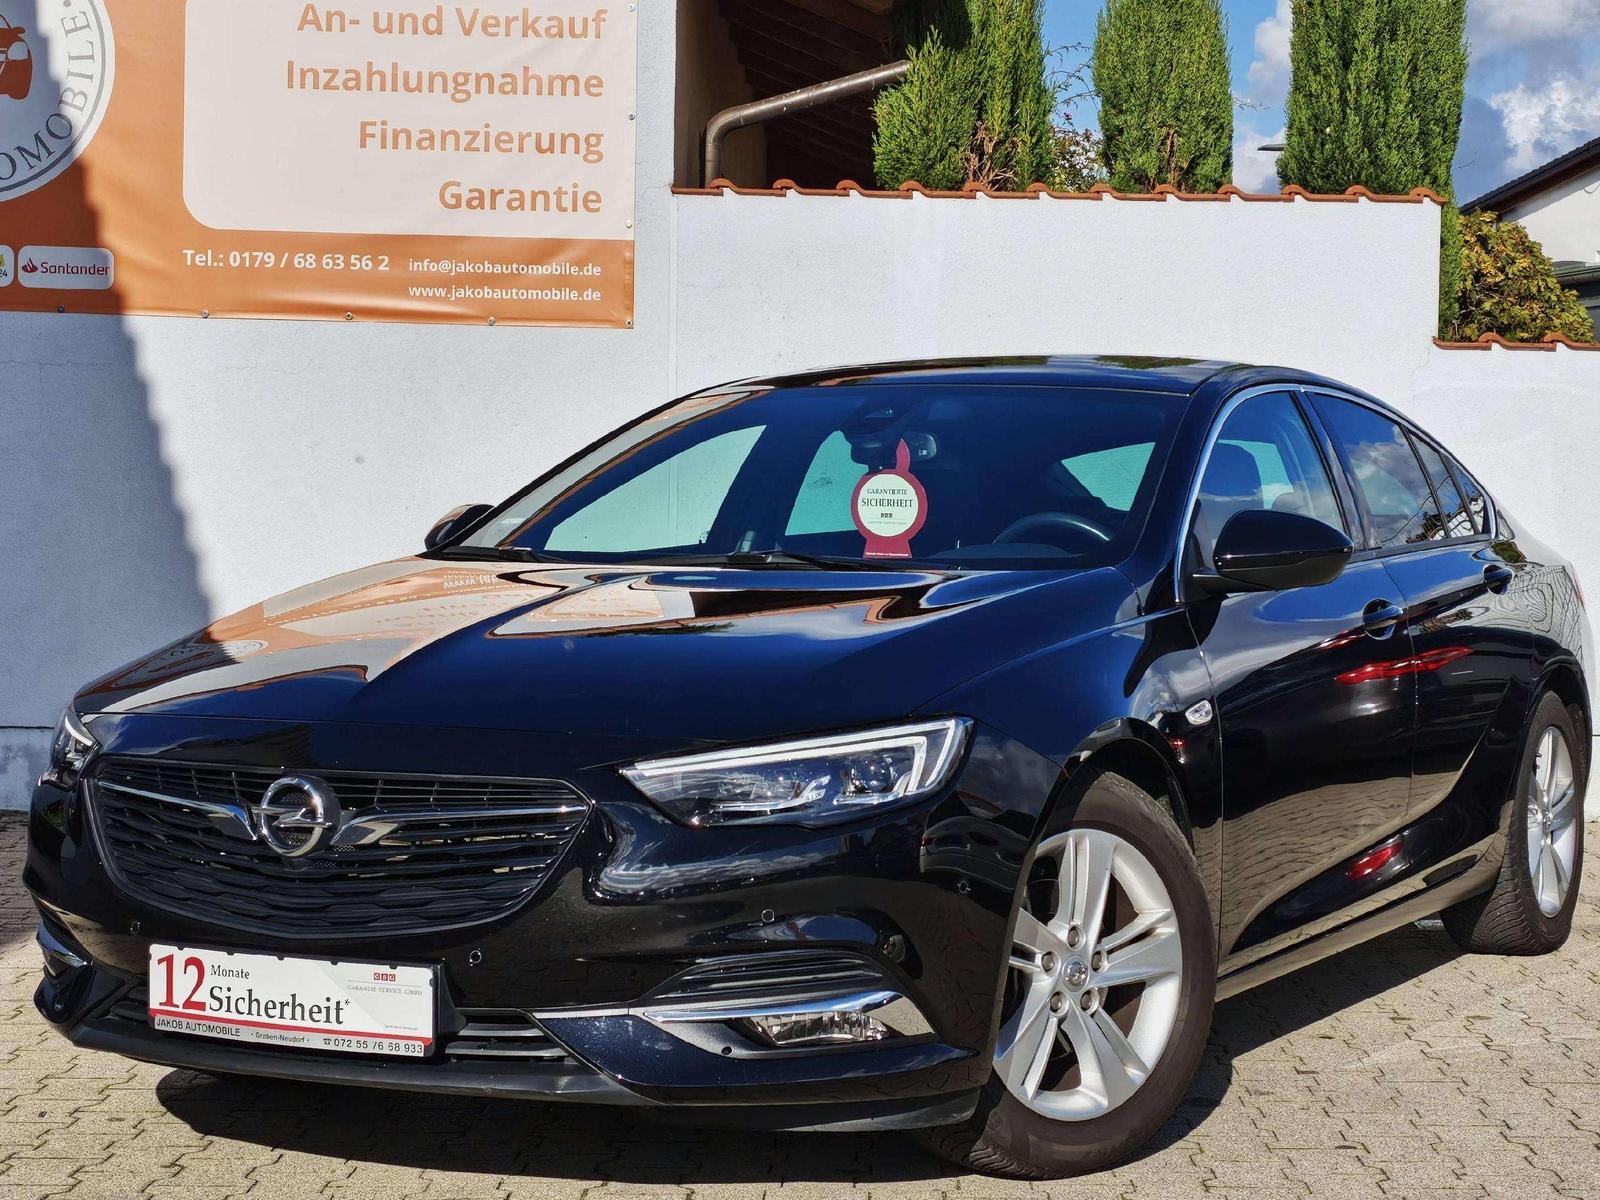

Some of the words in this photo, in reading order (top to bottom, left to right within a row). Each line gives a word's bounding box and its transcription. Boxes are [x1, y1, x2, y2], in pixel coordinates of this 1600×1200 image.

[297, 3, 360, 32] An-
[372, 5, 443, 35] und
[455, 8, 608, 39] Verkauf
[287, 60, 604, 103] Inzahlungnahme
[358, 120, 605, 164] Finanzierung
[438, 181, 603, 214] Garantie
[40, 261, 110, 276] Santander
[182, 249, 224, 268] Tel.:
[229, 250, 273, 270] 0179
[294, 253, 317, 271] 68
[322, 253, 345, 272] 63
[350, 254, 372, 272] 56
[377, 255, 389, 272] 2
[408, 257, 602, 278] info@jakobautomobile.de
[408, 284, 602, 303] www.jakobautomobile.de
[861, 498, 912, 508] SICHERHEIT
[157, 953, 206, 1012] 12
[210, 964, 250, 980] Monate
[156, 1017, 184, 1031] JAKOB
[185, 1021, 241, 1038] AUTOMOBILE
[333, 1038, 352, 1049] 072
[355, 1040, 369, 1050] 55
[372, 1042, 384, 1051] 76
[404, 1043, 424, 1055] 933
